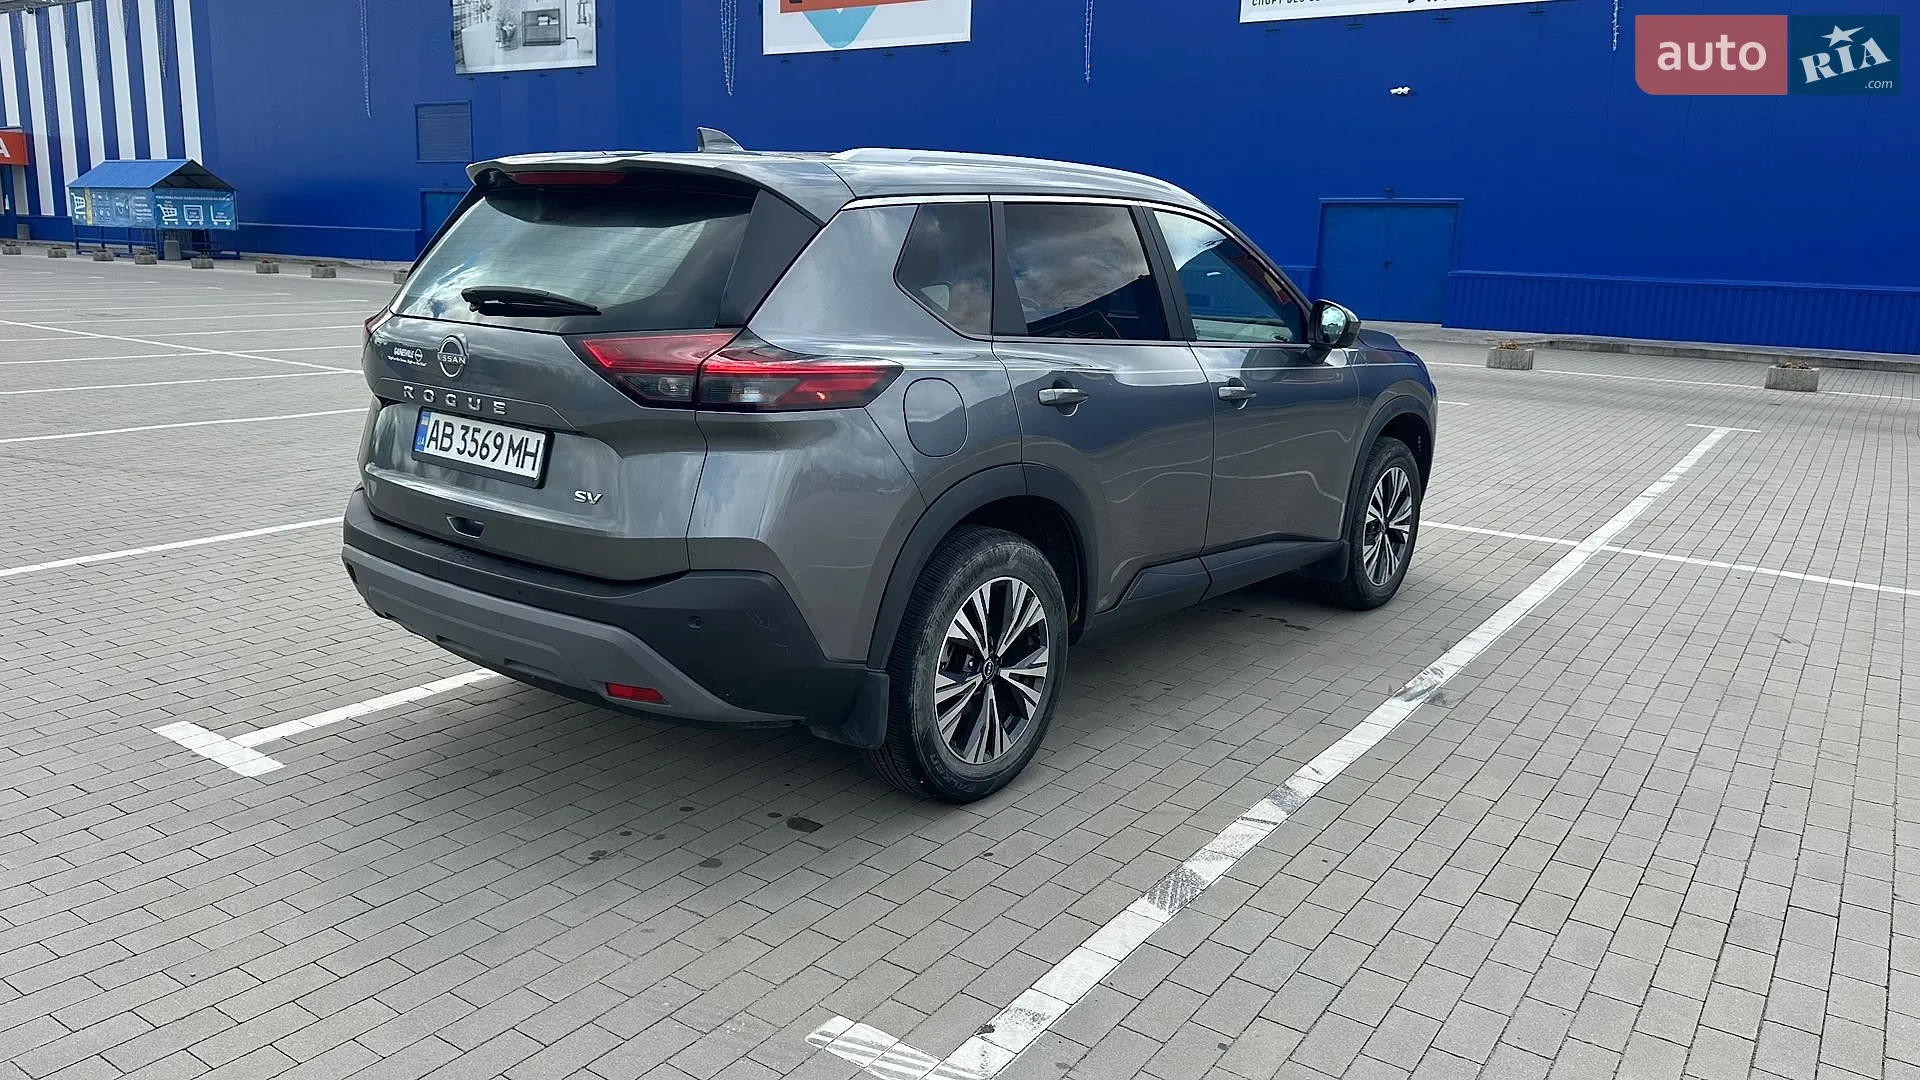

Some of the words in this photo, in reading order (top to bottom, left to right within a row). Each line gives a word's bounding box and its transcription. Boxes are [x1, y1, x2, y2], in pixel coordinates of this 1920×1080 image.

[402, 385, 508, 415] ROGUE
[426, 419, 455, 452] AB
[456, 424, 505, 463] 3569
[504, 434, 541, 472] MH
[573, 490, 604, 506] SV
